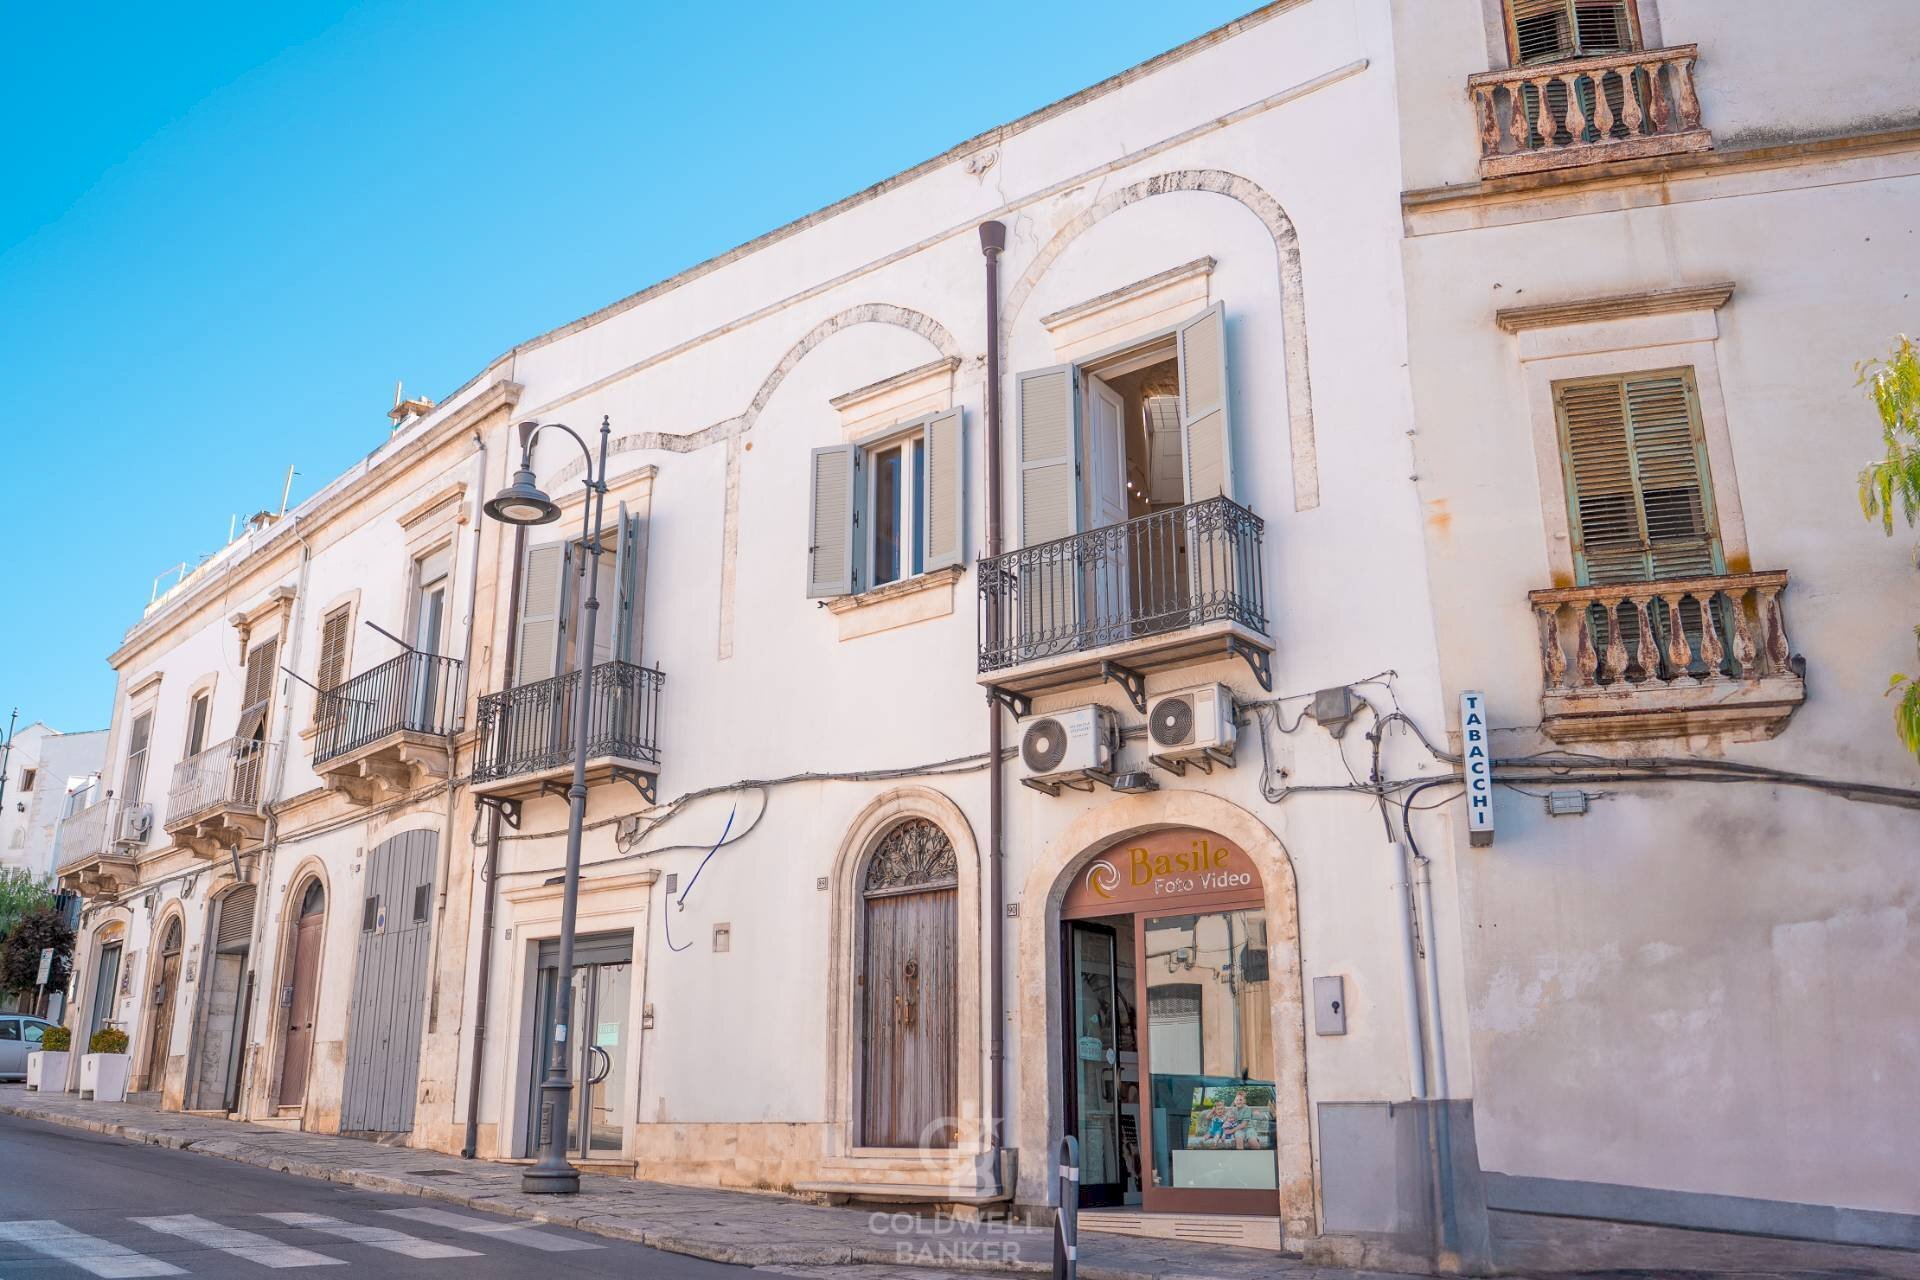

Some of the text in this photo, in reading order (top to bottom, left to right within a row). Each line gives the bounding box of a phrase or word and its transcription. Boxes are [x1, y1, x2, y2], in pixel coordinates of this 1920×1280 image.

[1466, 697, 1488, 824] TABACCHI
[1128, 840, 1229, 887] Basile
[1154, 872, 1251, 895] Foto Video
